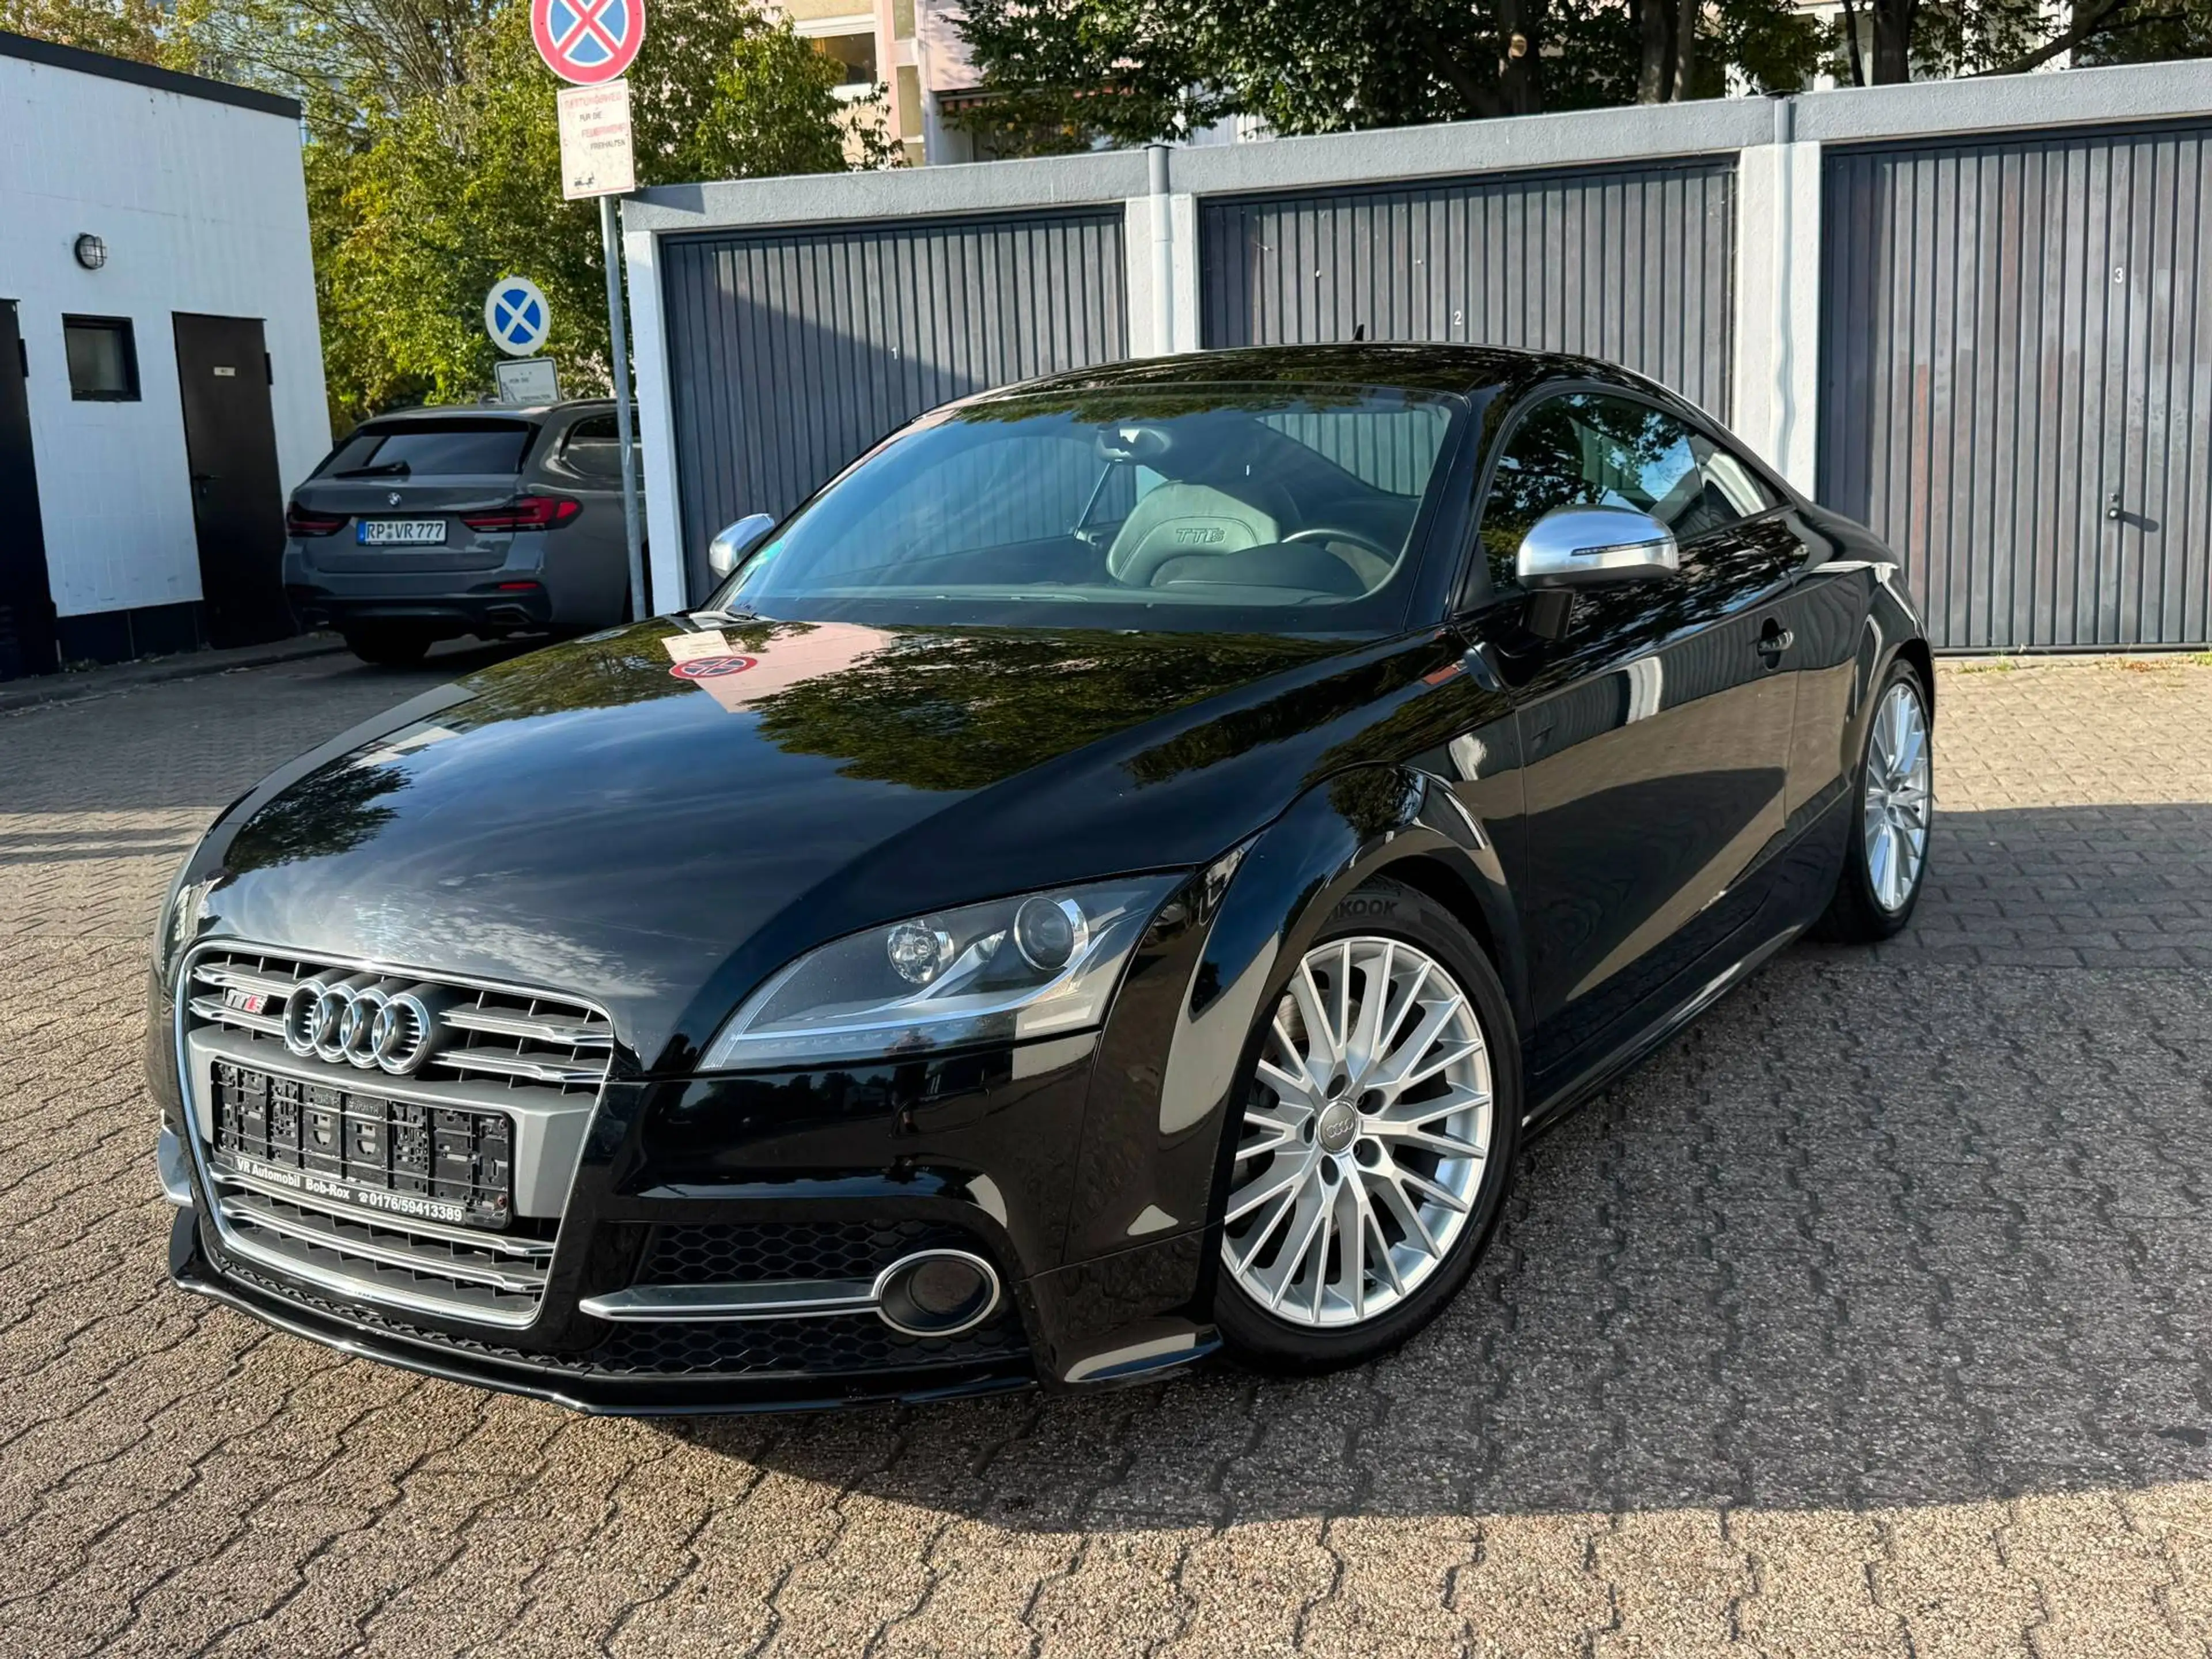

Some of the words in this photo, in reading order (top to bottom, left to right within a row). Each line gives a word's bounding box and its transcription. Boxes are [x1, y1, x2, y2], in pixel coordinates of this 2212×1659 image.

[2114, 267, 2123, 283] 3
[1453, 310, 1461, 325] 2
[892, 347, 897, 360] 1
[367, 523, 385, 539] RP
[395, 523, 412, 538] VR
[416, 523, 444, 538] 777
[236, 1158, 251, 1174] VR
[252, 1164, 301, 1188] Automobil
[305, 1178, 350, 1199] Bob-Rox
[369, 1192, 463, 1222] 0176/59413389
